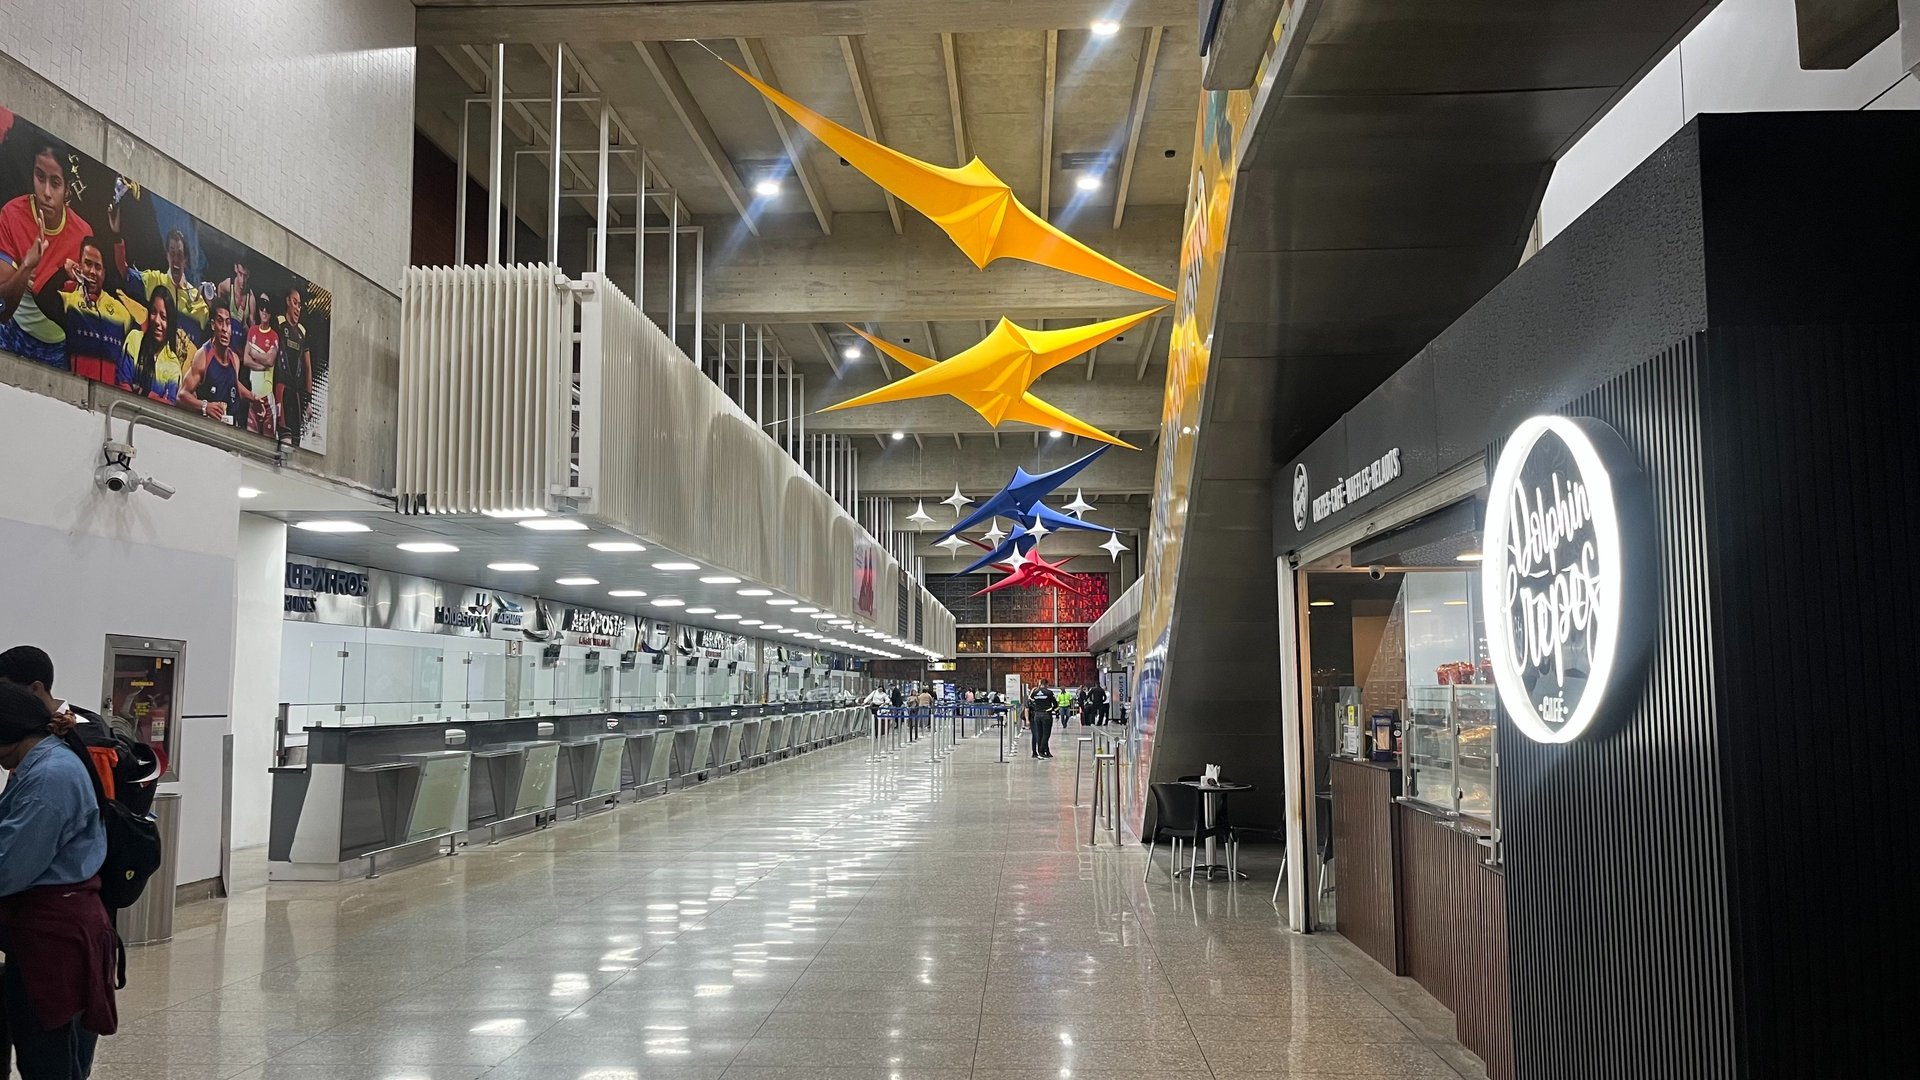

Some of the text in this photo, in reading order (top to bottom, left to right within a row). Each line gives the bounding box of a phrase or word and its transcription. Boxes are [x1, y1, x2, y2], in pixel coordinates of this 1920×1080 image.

[1506, 472, 1592, 576] Dolphin
[285, 563, 369, 596] LBATROS
[1503, 541, 1601, 687] Crepes
